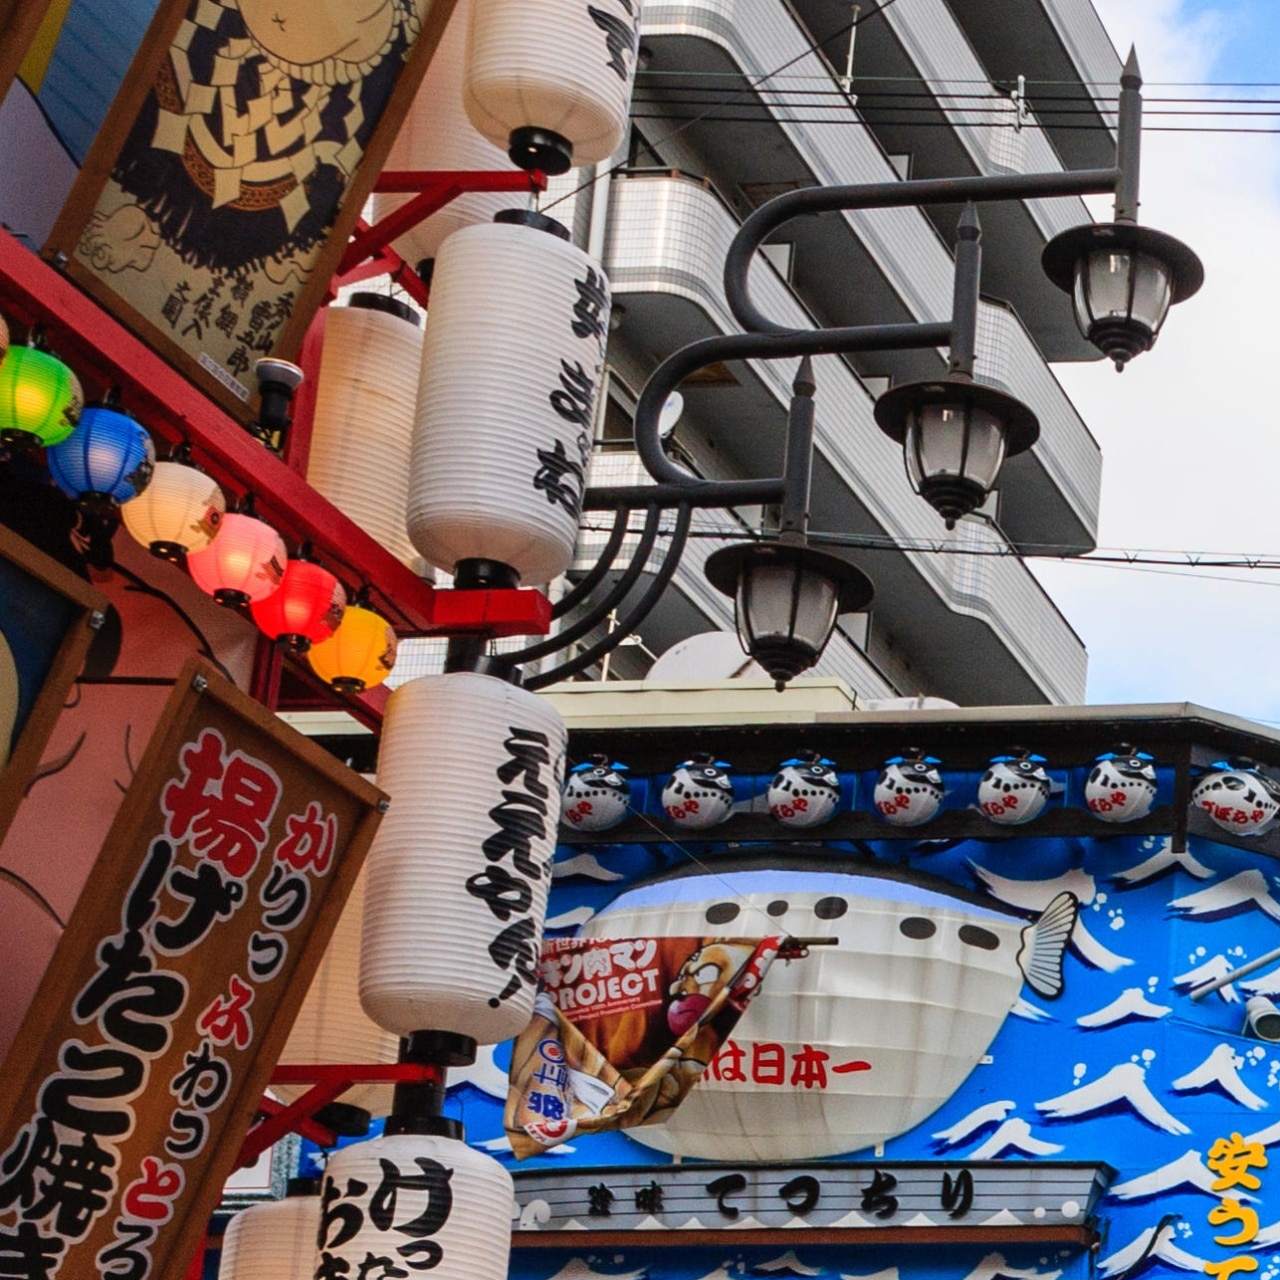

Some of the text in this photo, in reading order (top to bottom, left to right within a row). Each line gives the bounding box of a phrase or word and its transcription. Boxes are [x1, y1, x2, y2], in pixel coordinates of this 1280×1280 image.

[700, 1040, 872, 1089] は日本一
[705, 1169, 975, 1220] てっちり
